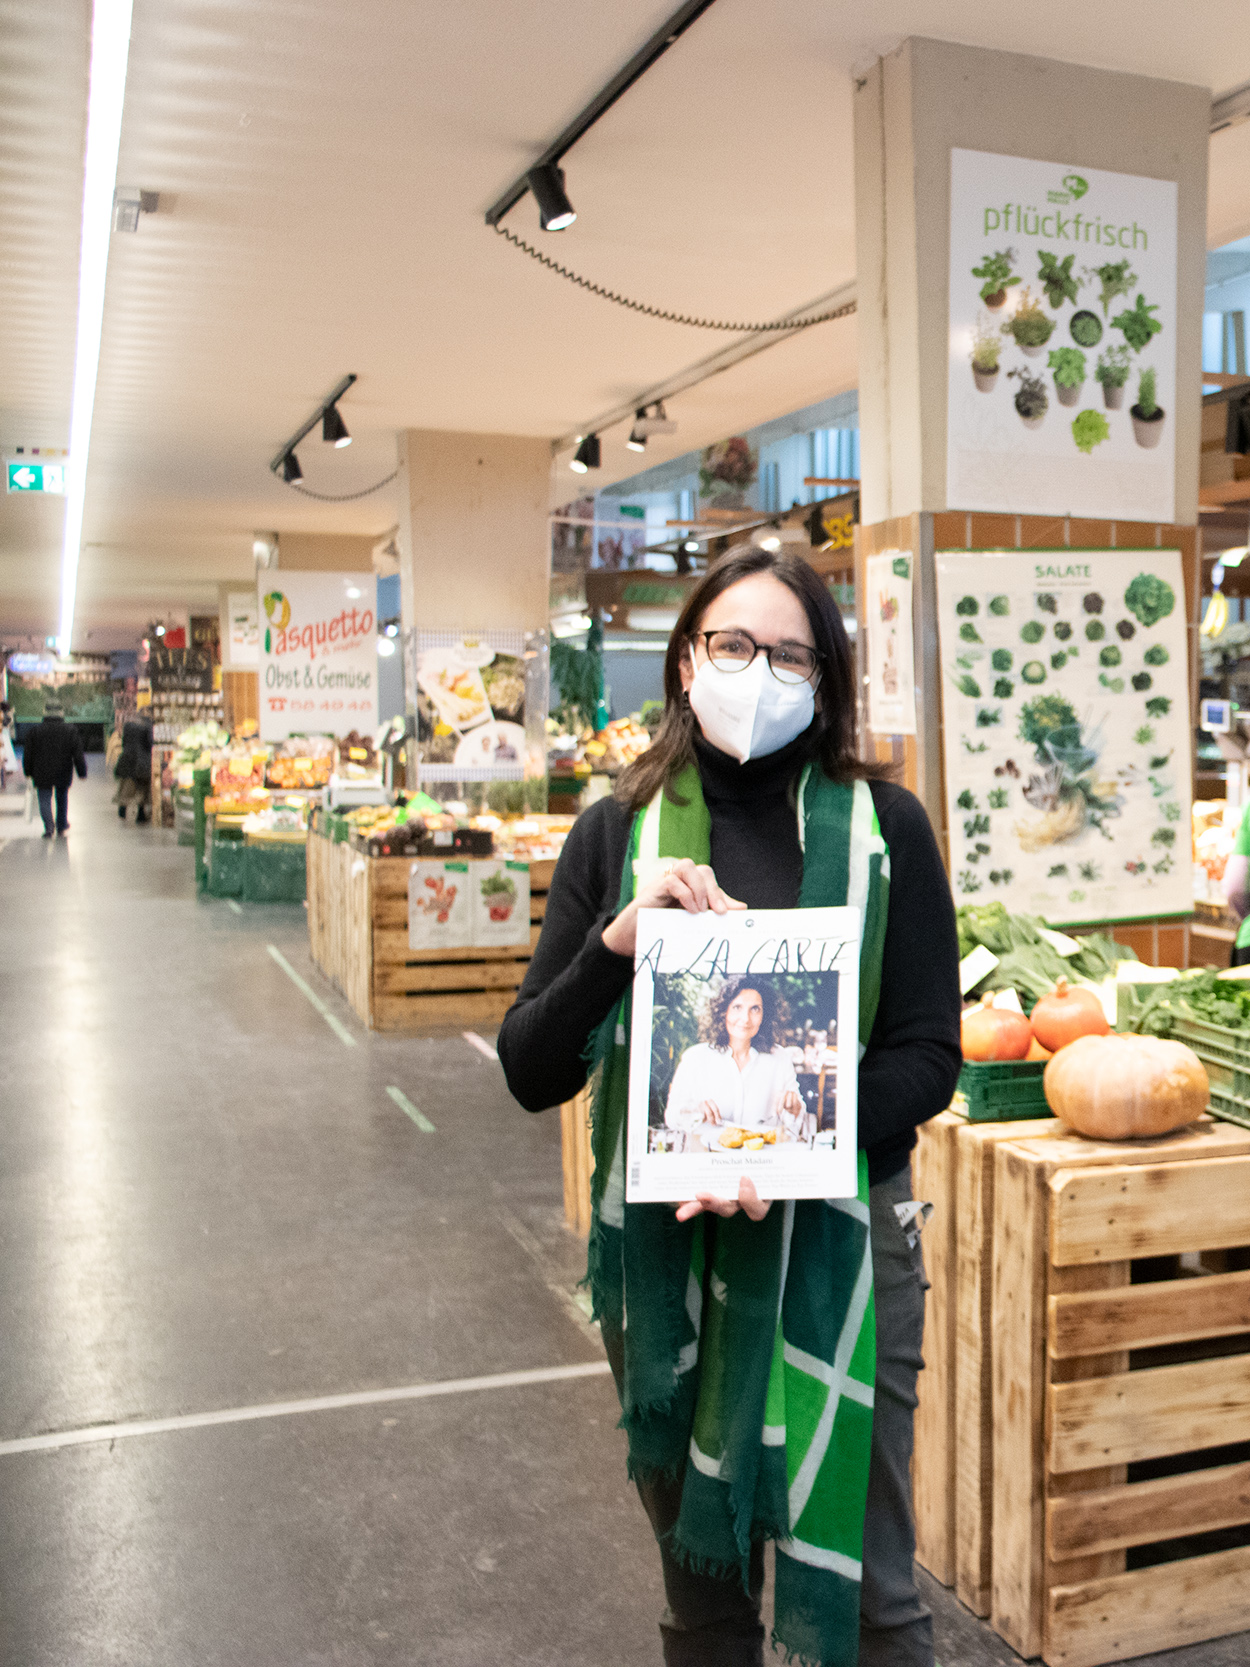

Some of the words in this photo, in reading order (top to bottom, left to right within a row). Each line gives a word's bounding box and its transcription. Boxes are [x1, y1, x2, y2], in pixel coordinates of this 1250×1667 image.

[984, 203, 1148, 251] pflückfrisch
[1035, 565, 1091, 578] SALATE
[265, 664, 300, 689] Obst
[303, 664, 313, 689] &
[317, 664, 371, 689] Gemüse
[635, 938, 668, 979] A
[675, 936, 730, 982] LA
[746, 935, 858, 975] CARTE
[745, 1157, 773, 1165] Madani
